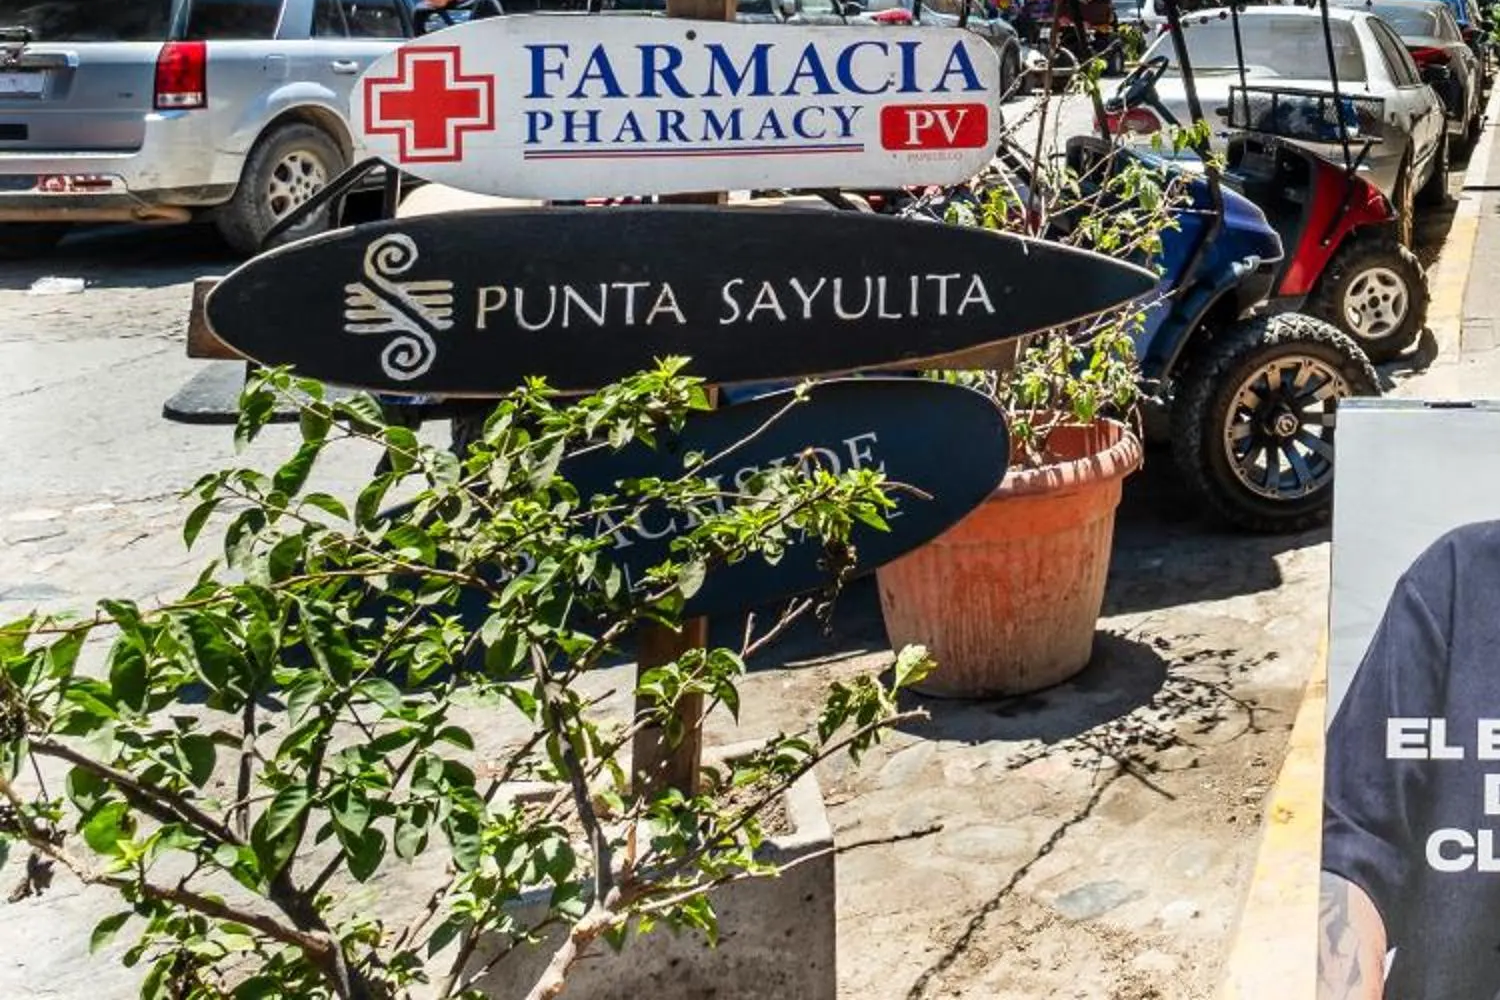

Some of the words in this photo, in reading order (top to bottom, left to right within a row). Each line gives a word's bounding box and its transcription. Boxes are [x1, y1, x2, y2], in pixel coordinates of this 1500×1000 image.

[524, 39, 988, 99] FARMACIA
[524, 103, 866, 145] PHARMACY
[903, 109, 969, 146] PV
[476, 282, 687, 332] PUNTA
[719, 272, 996, 326] SAYULITA
[1385, 717, 1463, 760] EL
